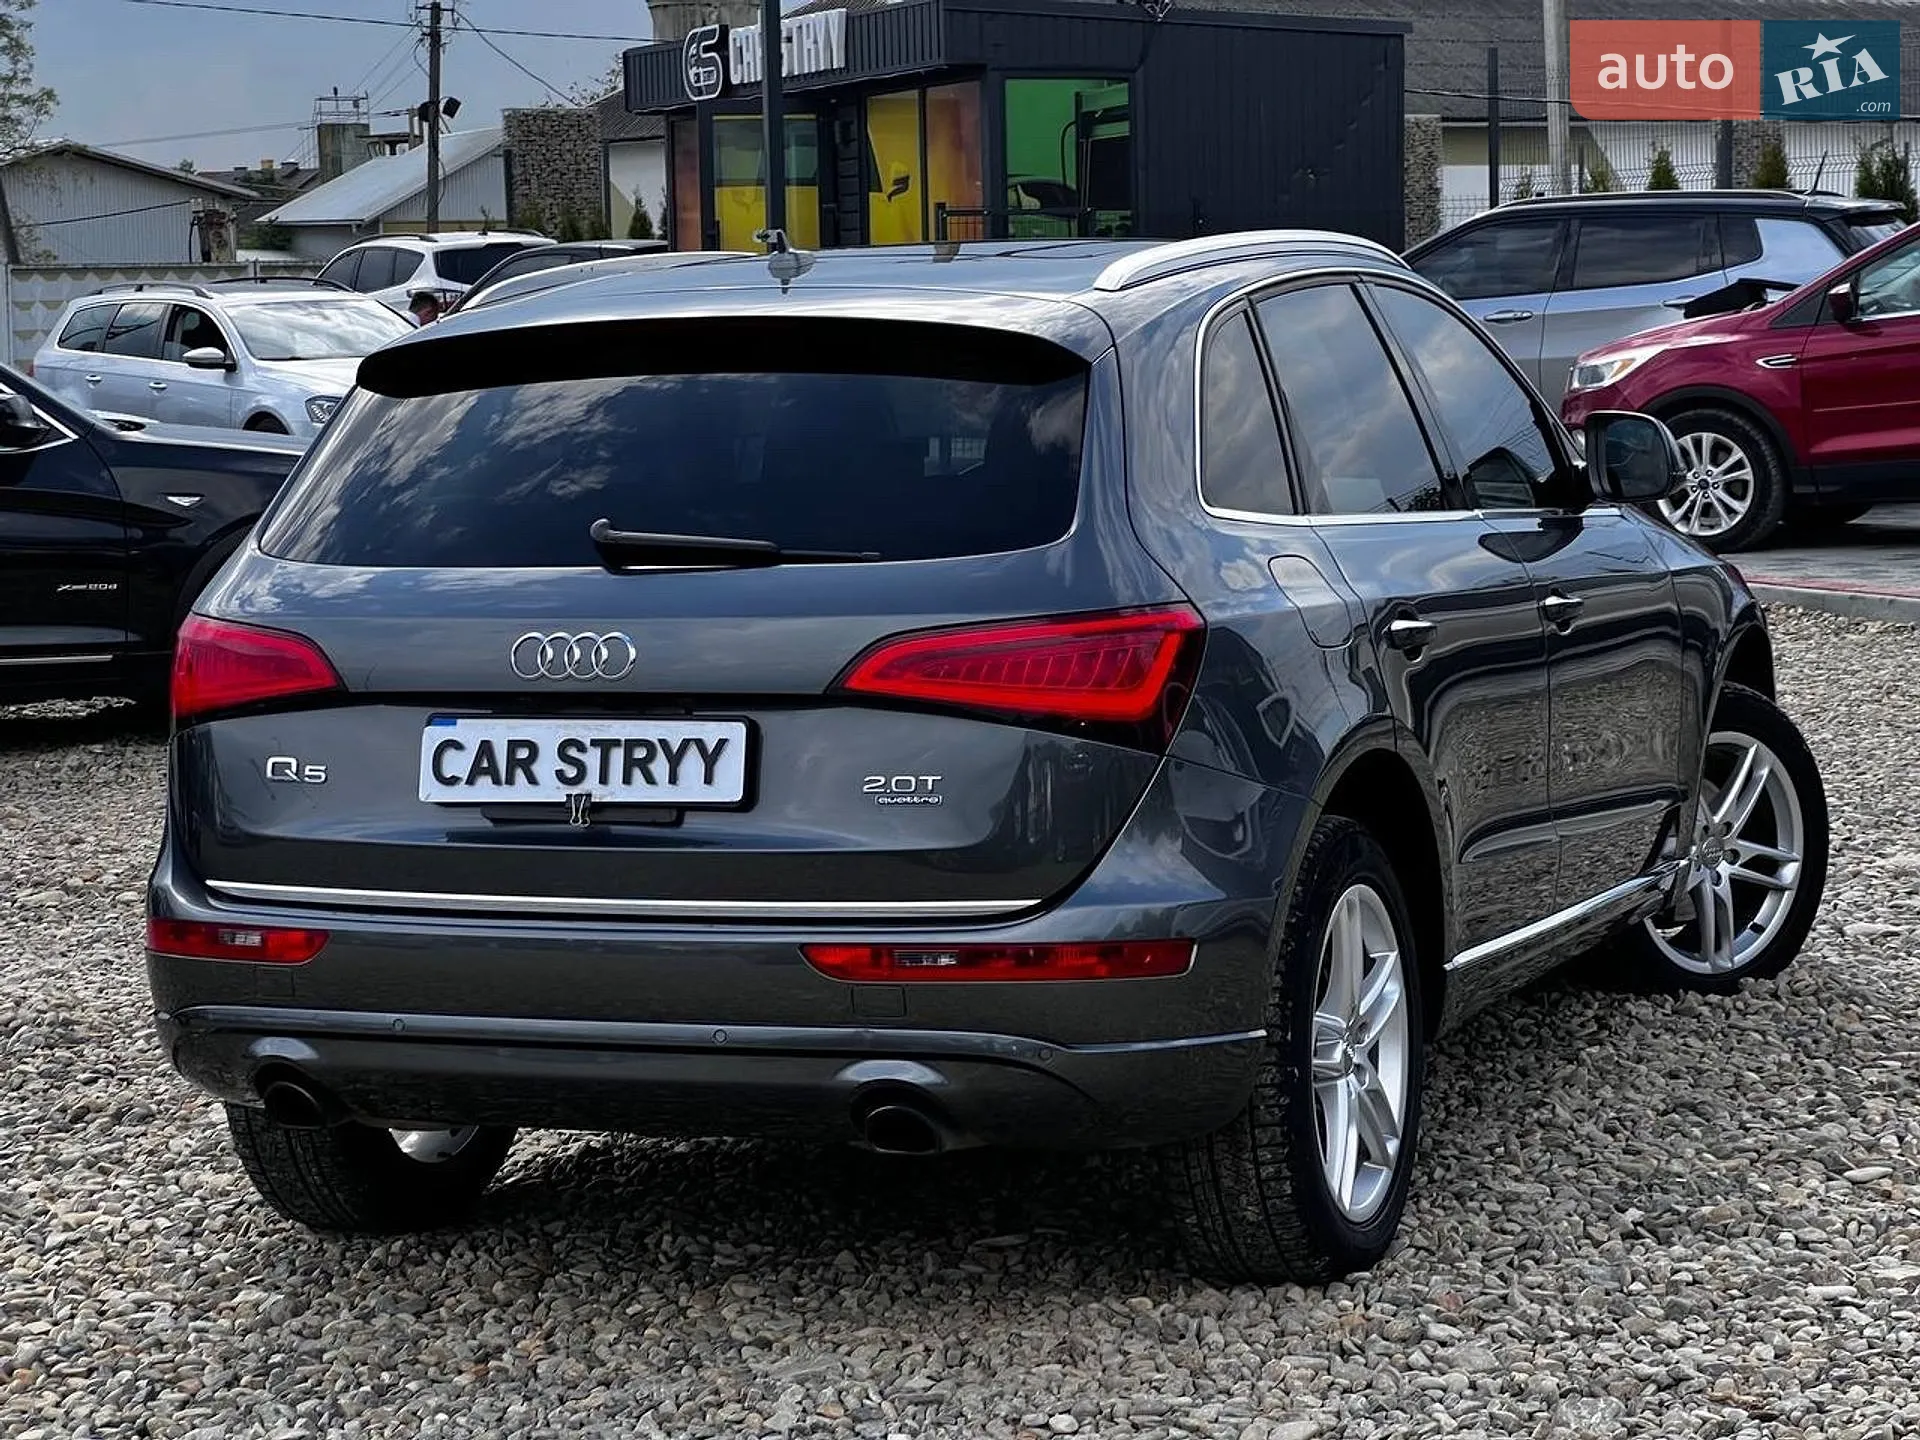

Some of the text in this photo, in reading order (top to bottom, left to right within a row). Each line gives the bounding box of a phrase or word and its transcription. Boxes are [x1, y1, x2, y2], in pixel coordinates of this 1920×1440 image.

[265, 755, 327, 784] Q5
[431, 737, 729, 787] CAR STRYY
[862, 774, 943, 793] 2.0T
[876, 795, 941, 806] quattro
